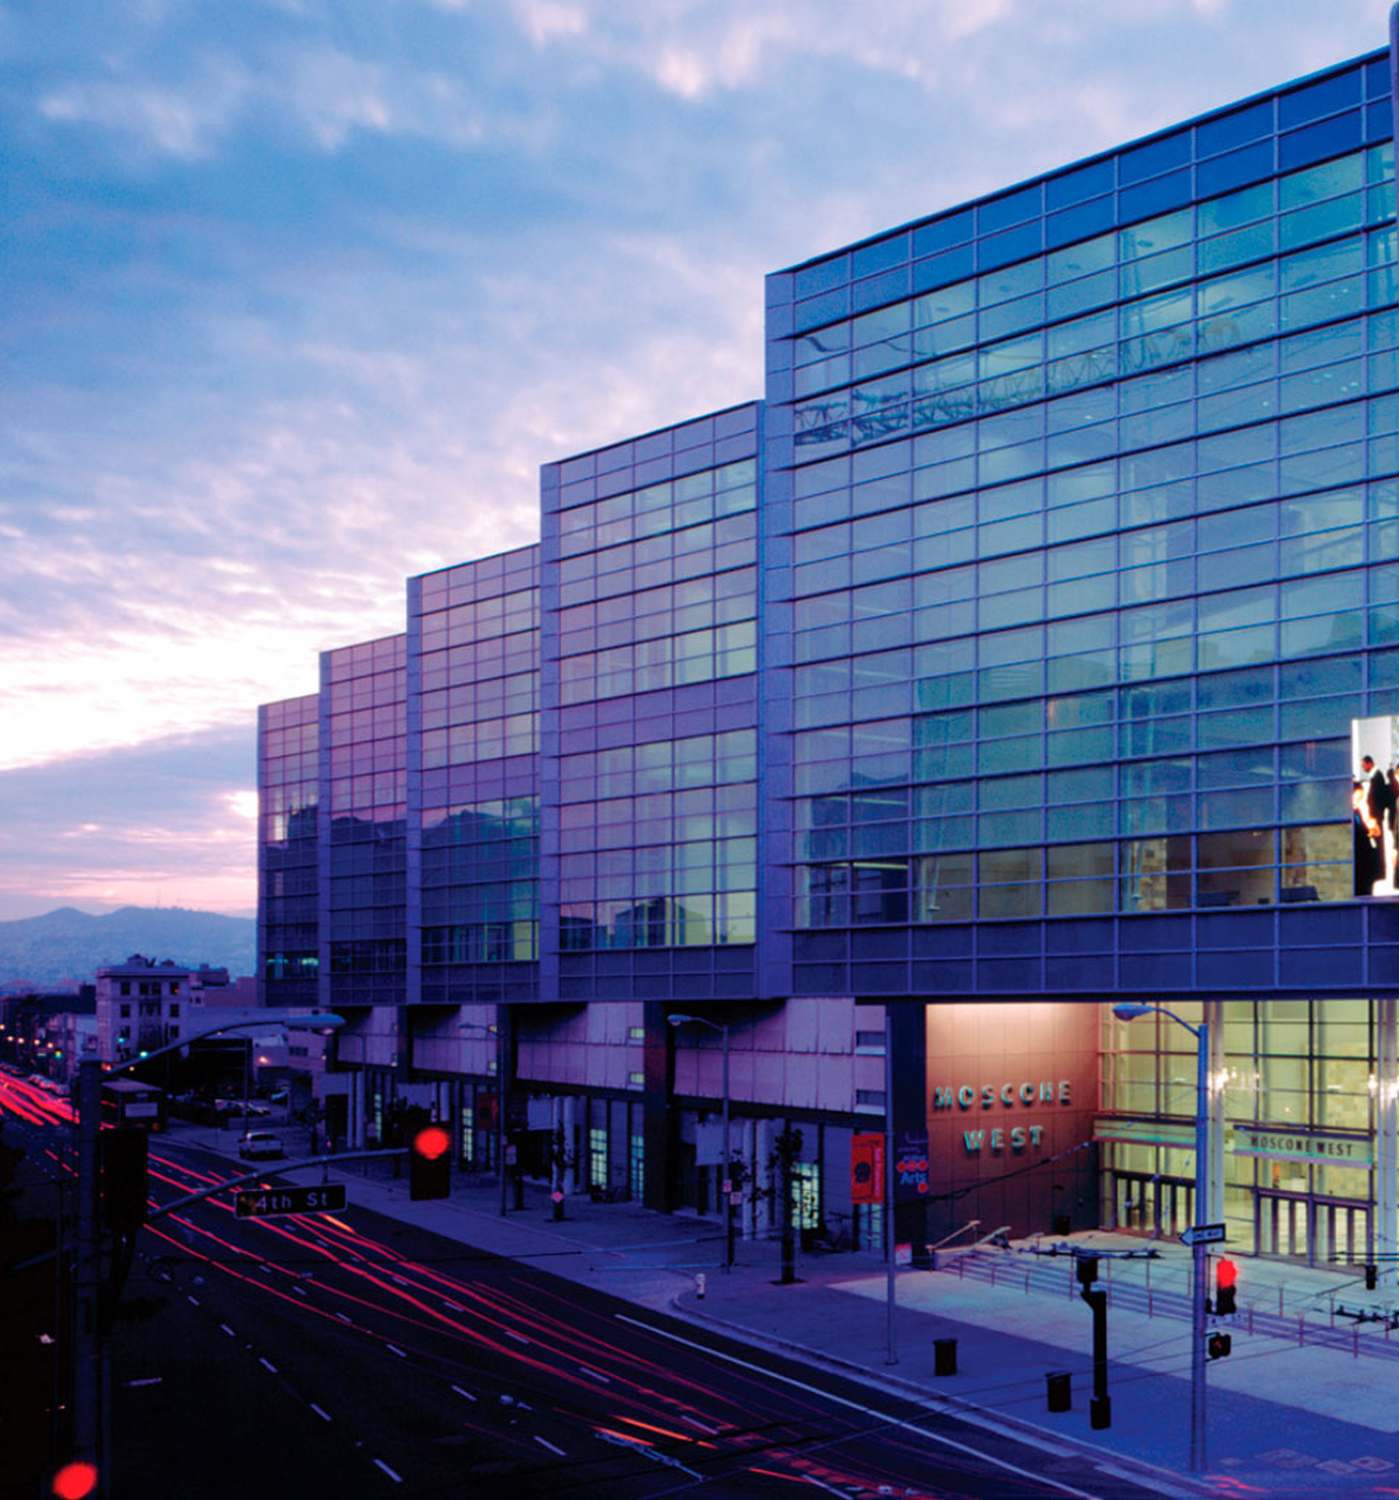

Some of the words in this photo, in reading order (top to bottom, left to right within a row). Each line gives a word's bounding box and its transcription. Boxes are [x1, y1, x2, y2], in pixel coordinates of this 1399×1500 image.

[933, 1081, 1071, 1107] MOSCONE
[963, 1125, 1043, 1150] WEST
[1250, 1136, 1312, 1153] MOSCONE
[1317, 1141, 1353, 1157] WEST
[256, 1195, 292, 1212] 4th
[306, 1192, 328, 1207] St
